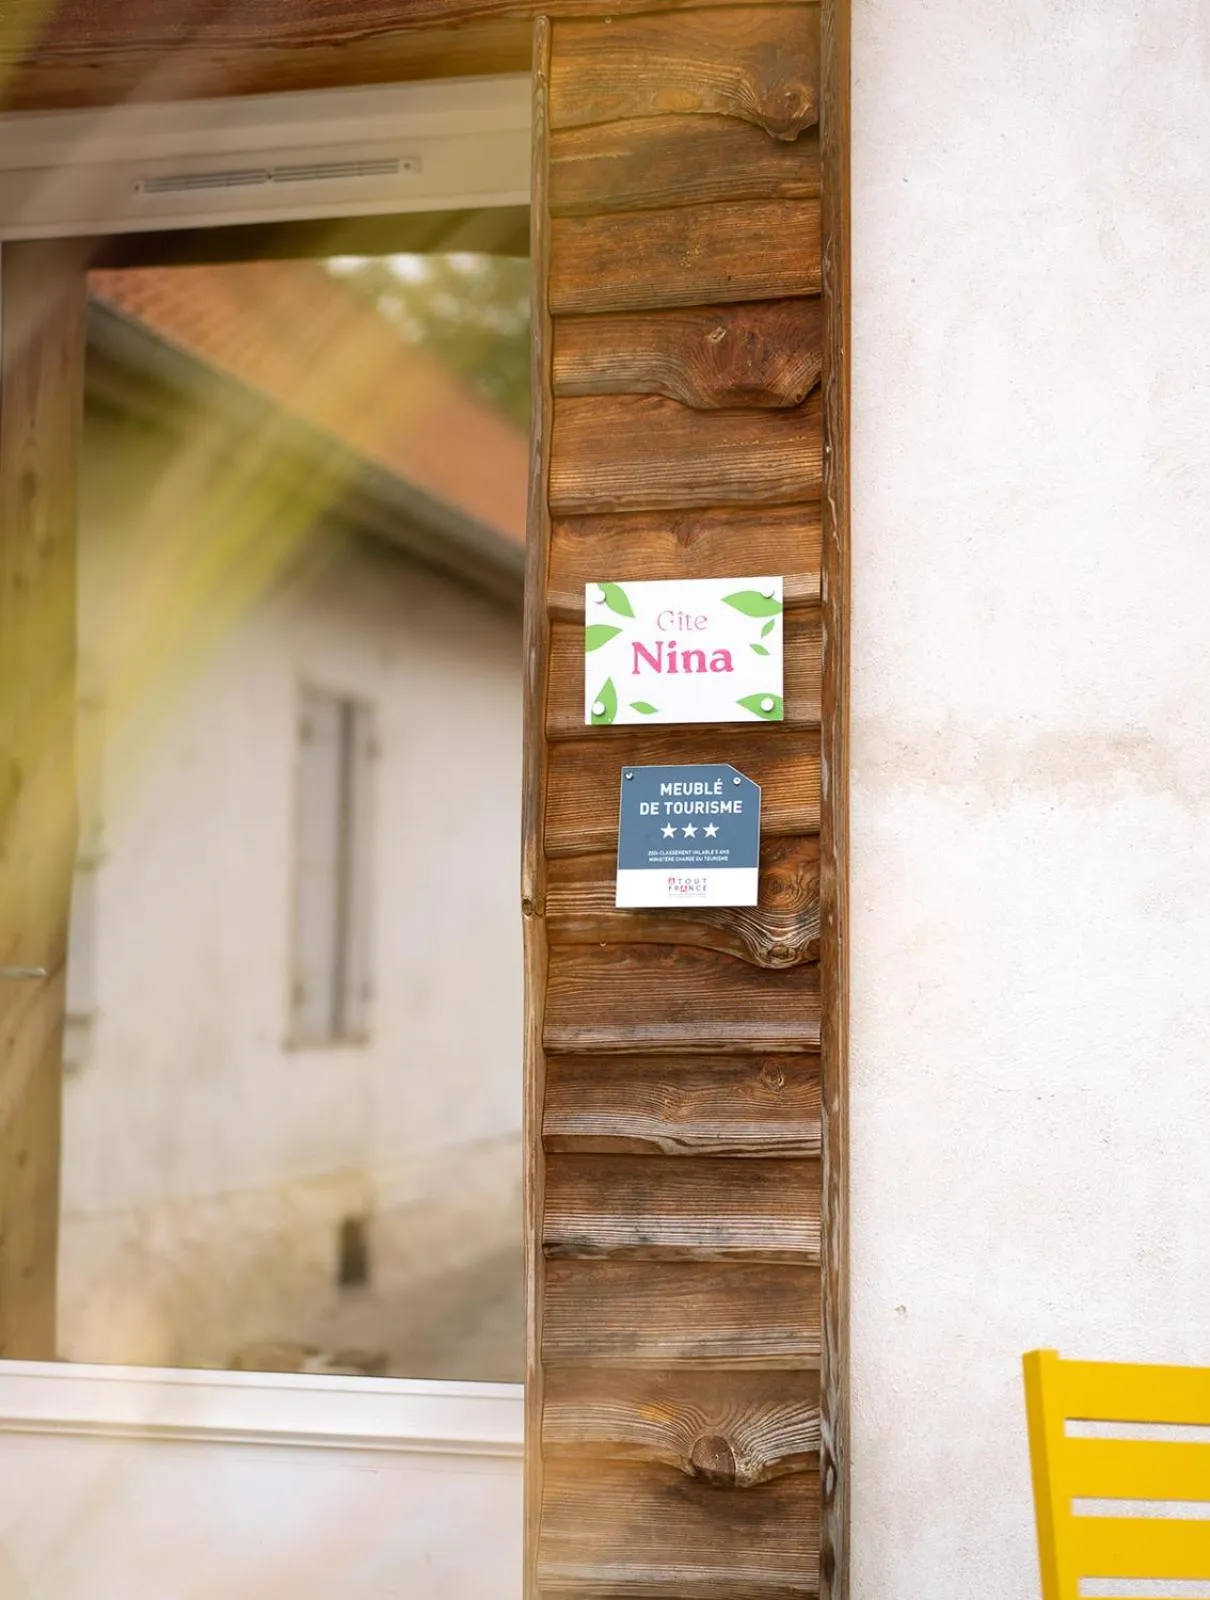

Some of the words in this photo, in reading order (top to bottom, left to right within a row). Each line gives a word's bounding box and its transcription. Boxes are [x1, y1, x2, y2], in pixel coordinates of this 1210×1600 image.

[631, 640, 734, 675] Nina
[660, 778, 723, 796] MEUBLÉ
[640, 802, 659, 815] DE
[664, 800, 743, 815] TOURISME
